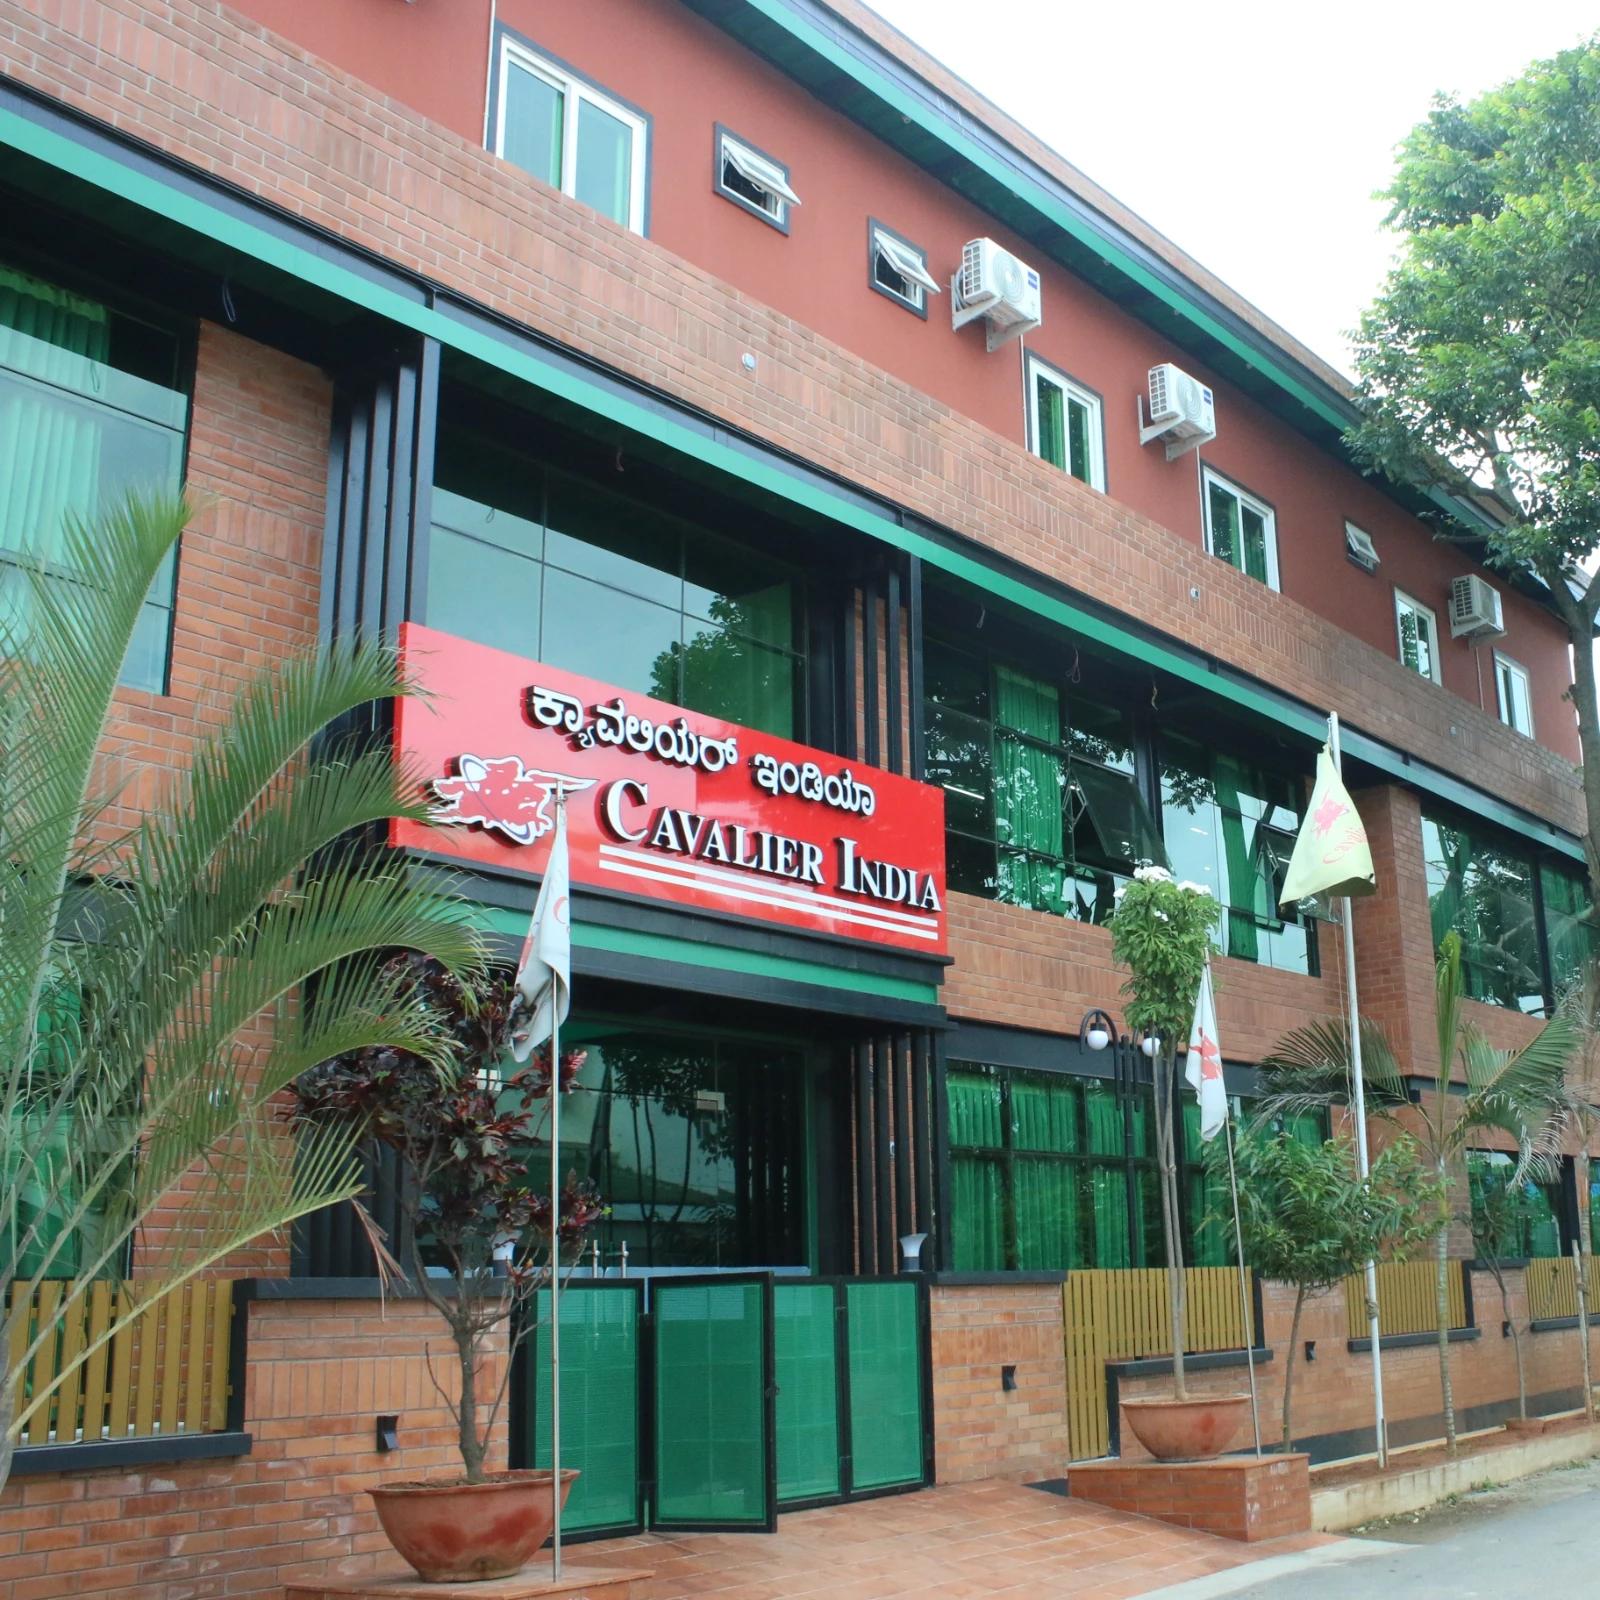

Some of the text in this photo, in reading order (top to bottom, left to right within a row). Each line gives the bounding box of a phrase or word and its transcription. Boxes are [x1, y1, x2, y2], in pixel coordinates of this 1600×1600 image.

[753, 753, 876, 816] ಇಂಡಿಯಾ
[606, 778, 942, 912] CAVALIER INDIA
